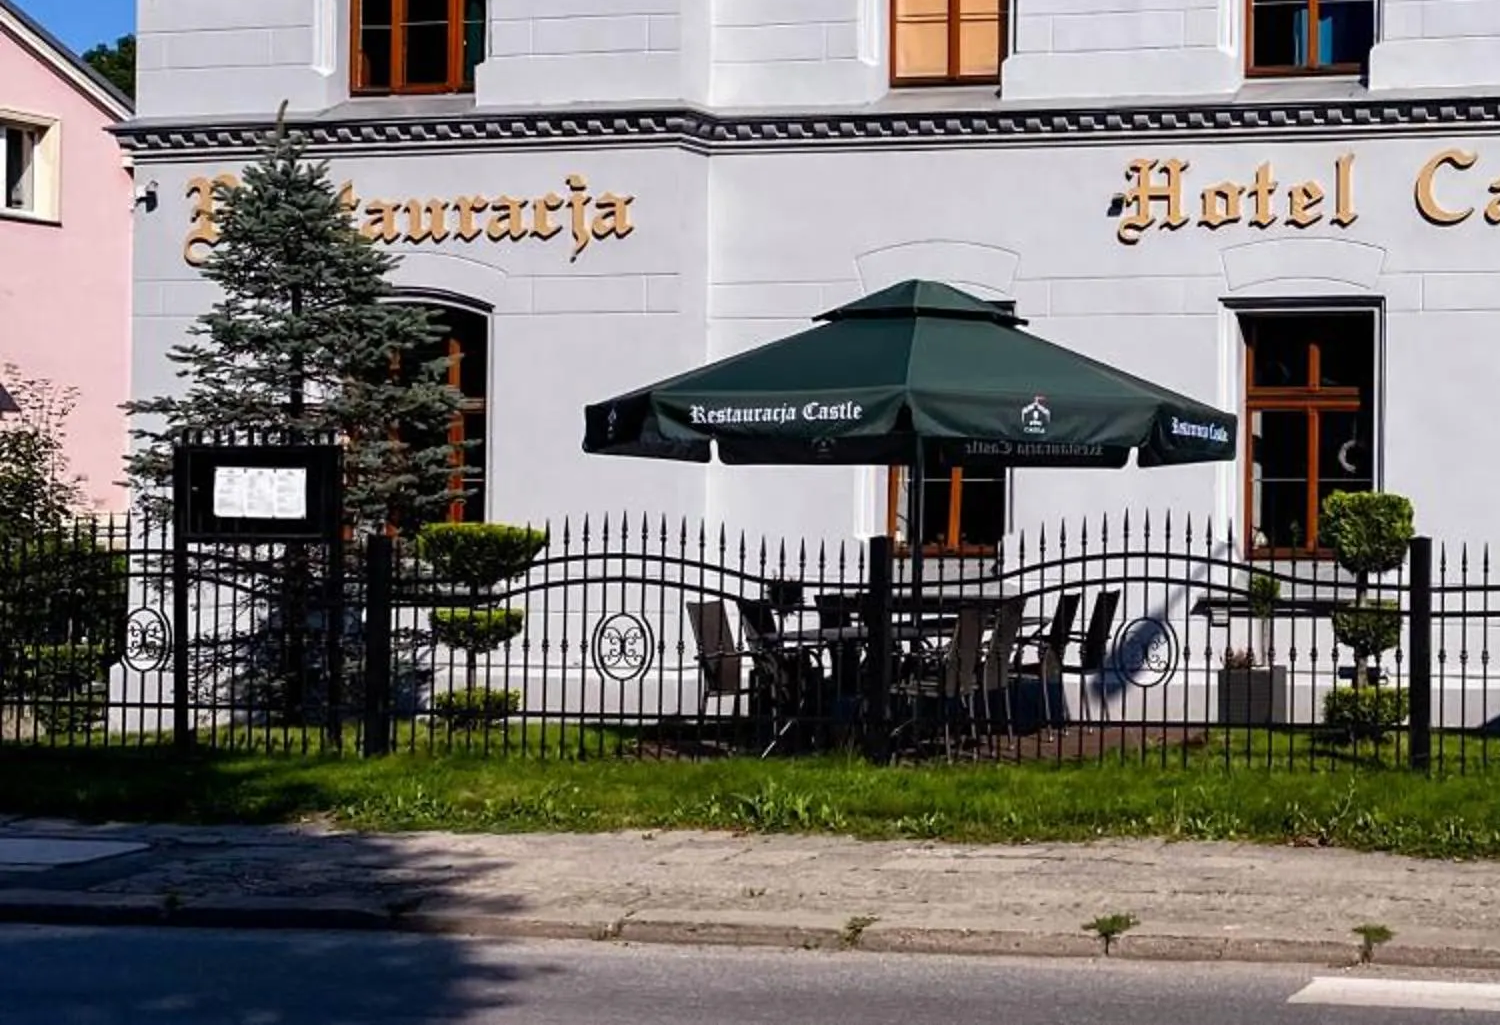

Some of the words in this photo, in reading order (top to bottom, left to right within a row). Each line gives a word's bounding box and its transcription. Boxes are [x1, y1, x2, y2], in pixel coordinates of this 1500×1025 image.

[184, 173, 635, 267] Rauracja
[1118, 153, 1359, 245] Hotel
[689, 403, 797, 424] Restauracja
[802, 401, 862, 421] Castle
